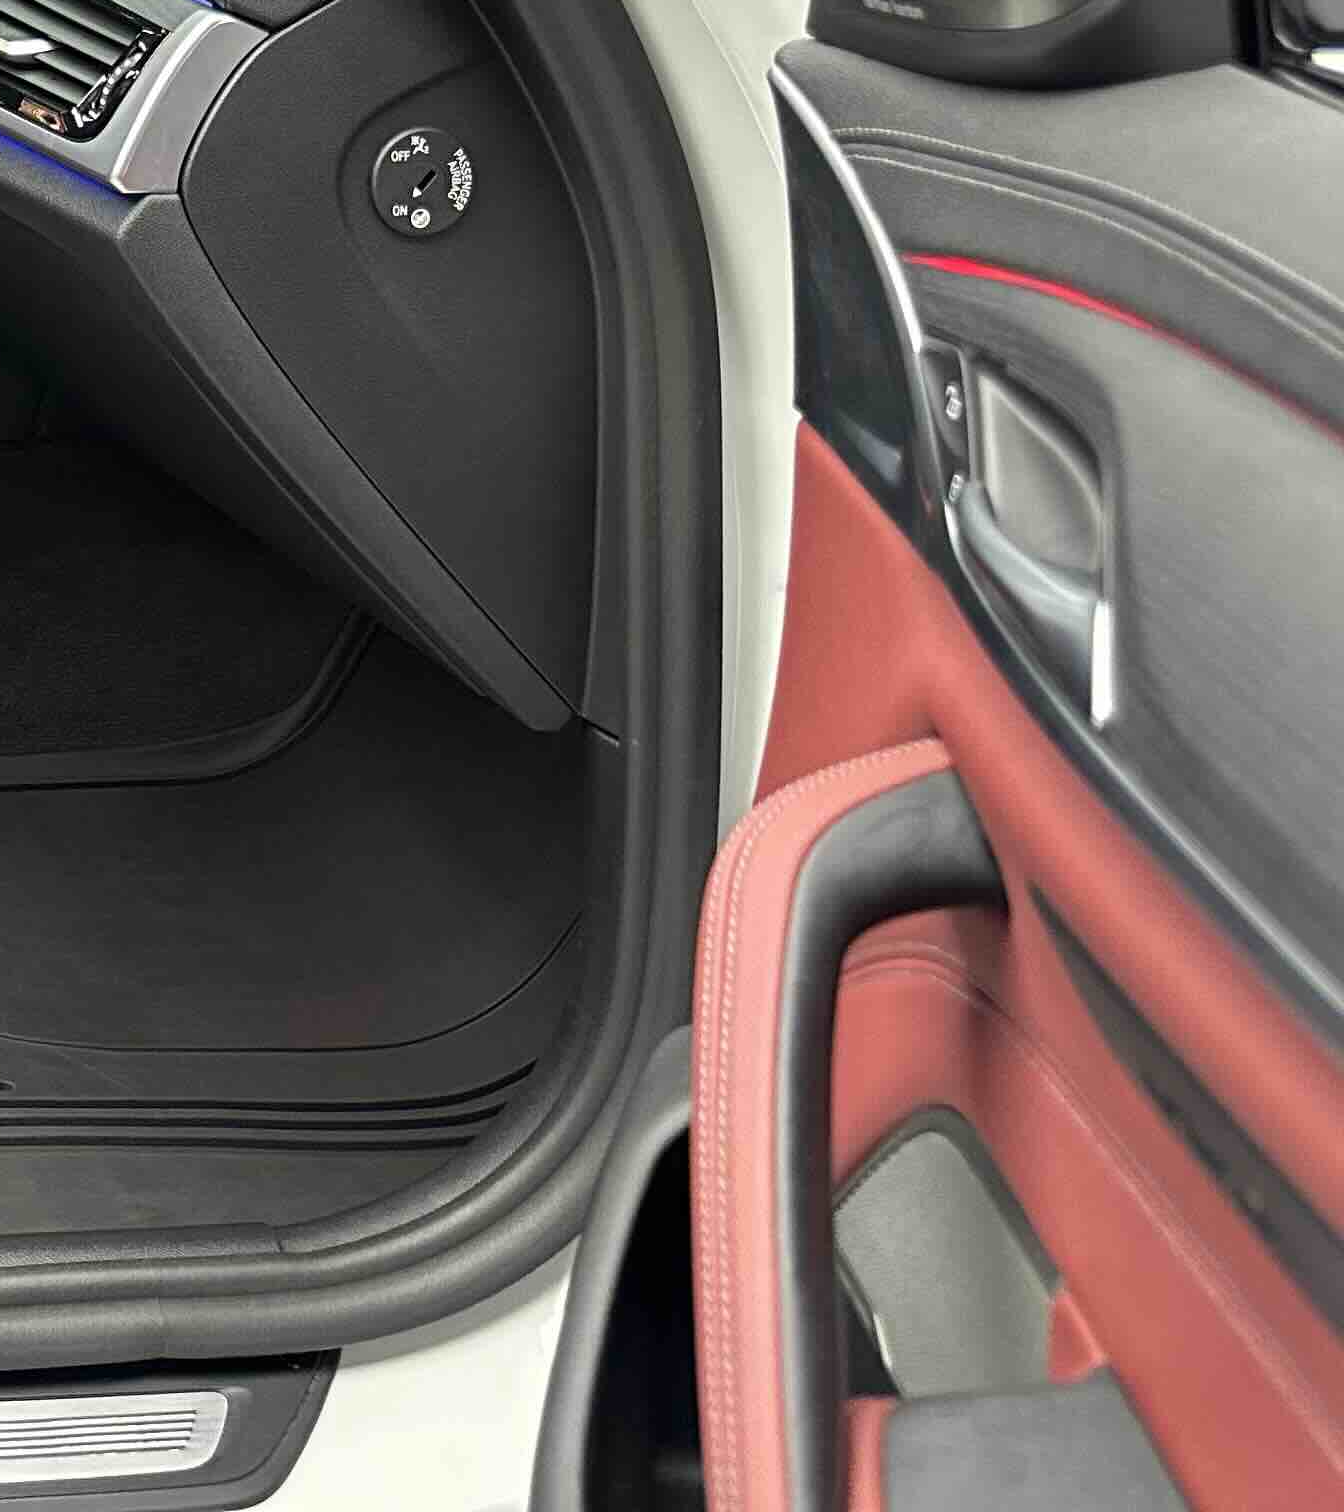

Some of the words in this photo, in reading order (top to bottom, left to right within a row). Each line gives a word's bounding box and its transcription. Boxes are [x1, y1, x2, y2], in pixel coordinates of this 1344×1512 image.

[390, 150, 411, 162] OFF
[447, 160, 462, 200] AIRBAG
[452, 148, 473, 212] PASSENGER
[392, 204, 409, 217] ON
